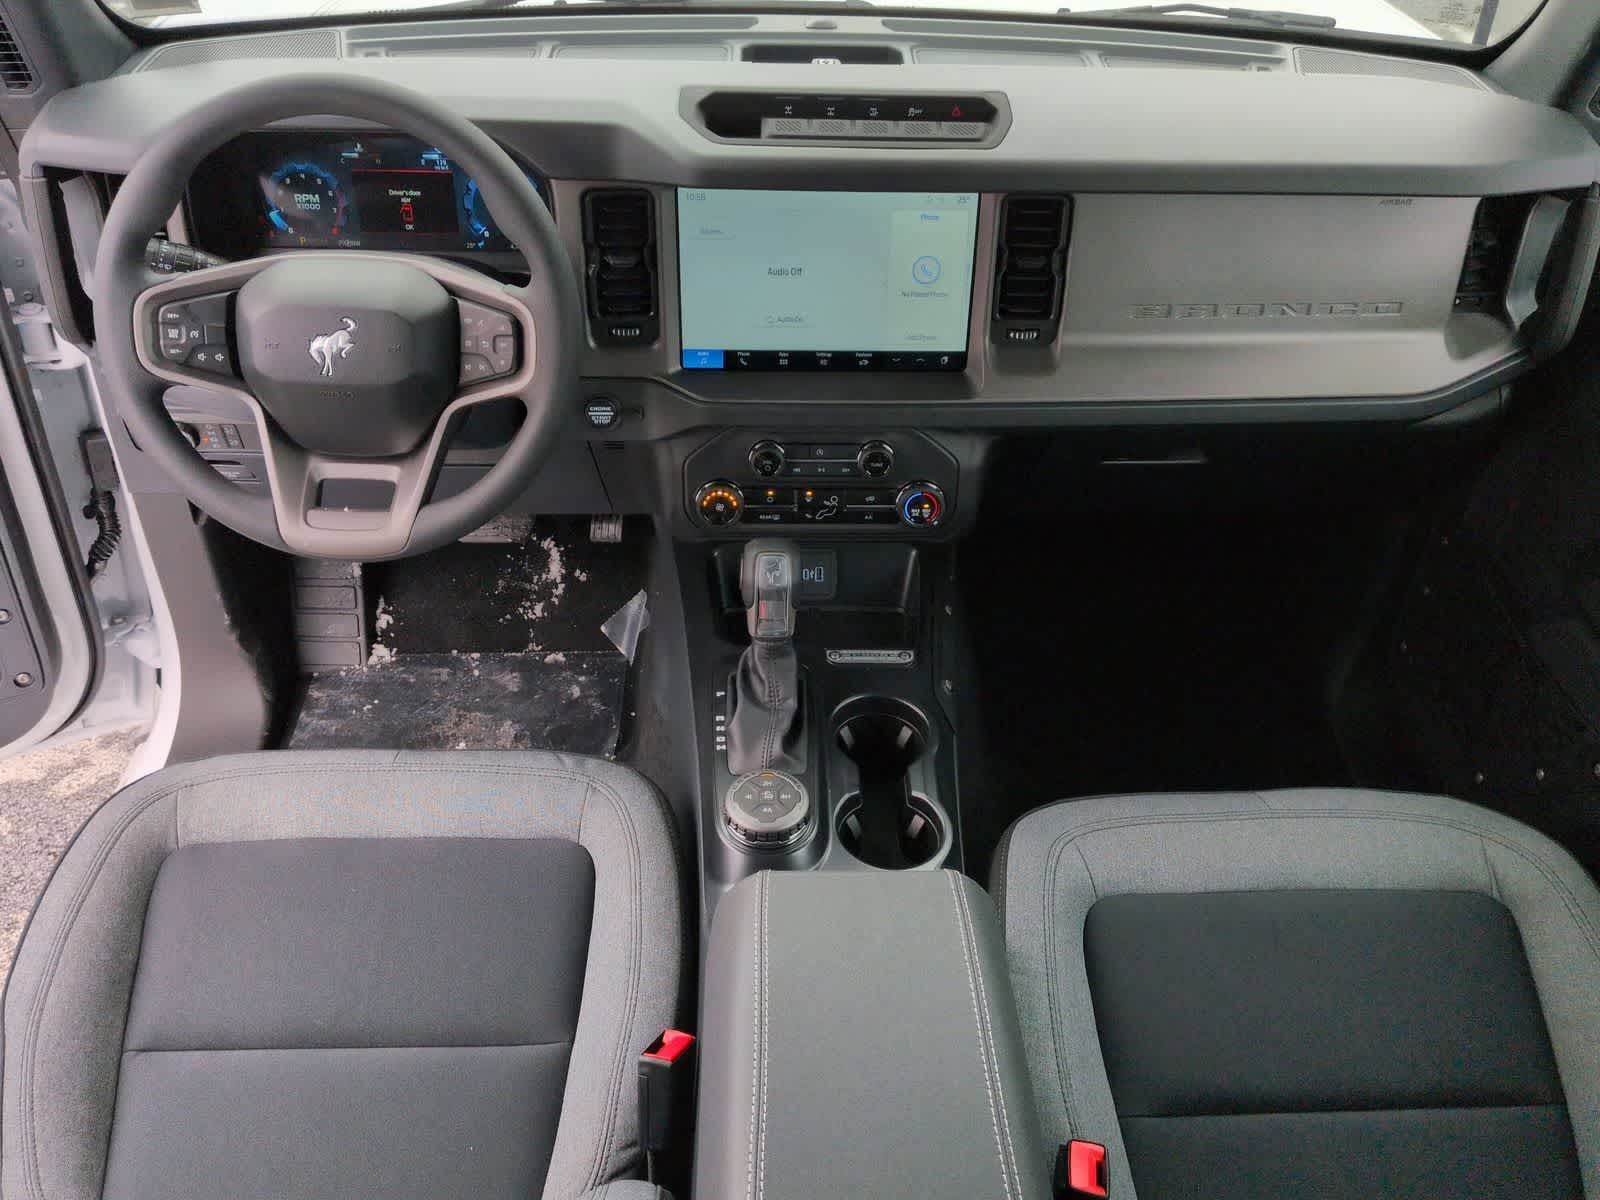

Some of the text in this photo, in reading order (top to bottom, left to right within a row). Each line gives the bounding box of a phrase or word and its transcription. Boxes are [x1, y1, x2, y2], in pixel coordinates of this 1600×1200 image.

[294, 194, 320, 203] RPM
[767, 267, 803, 278] Audio Off
[1130, 302, 1403, 319] BRONCO
